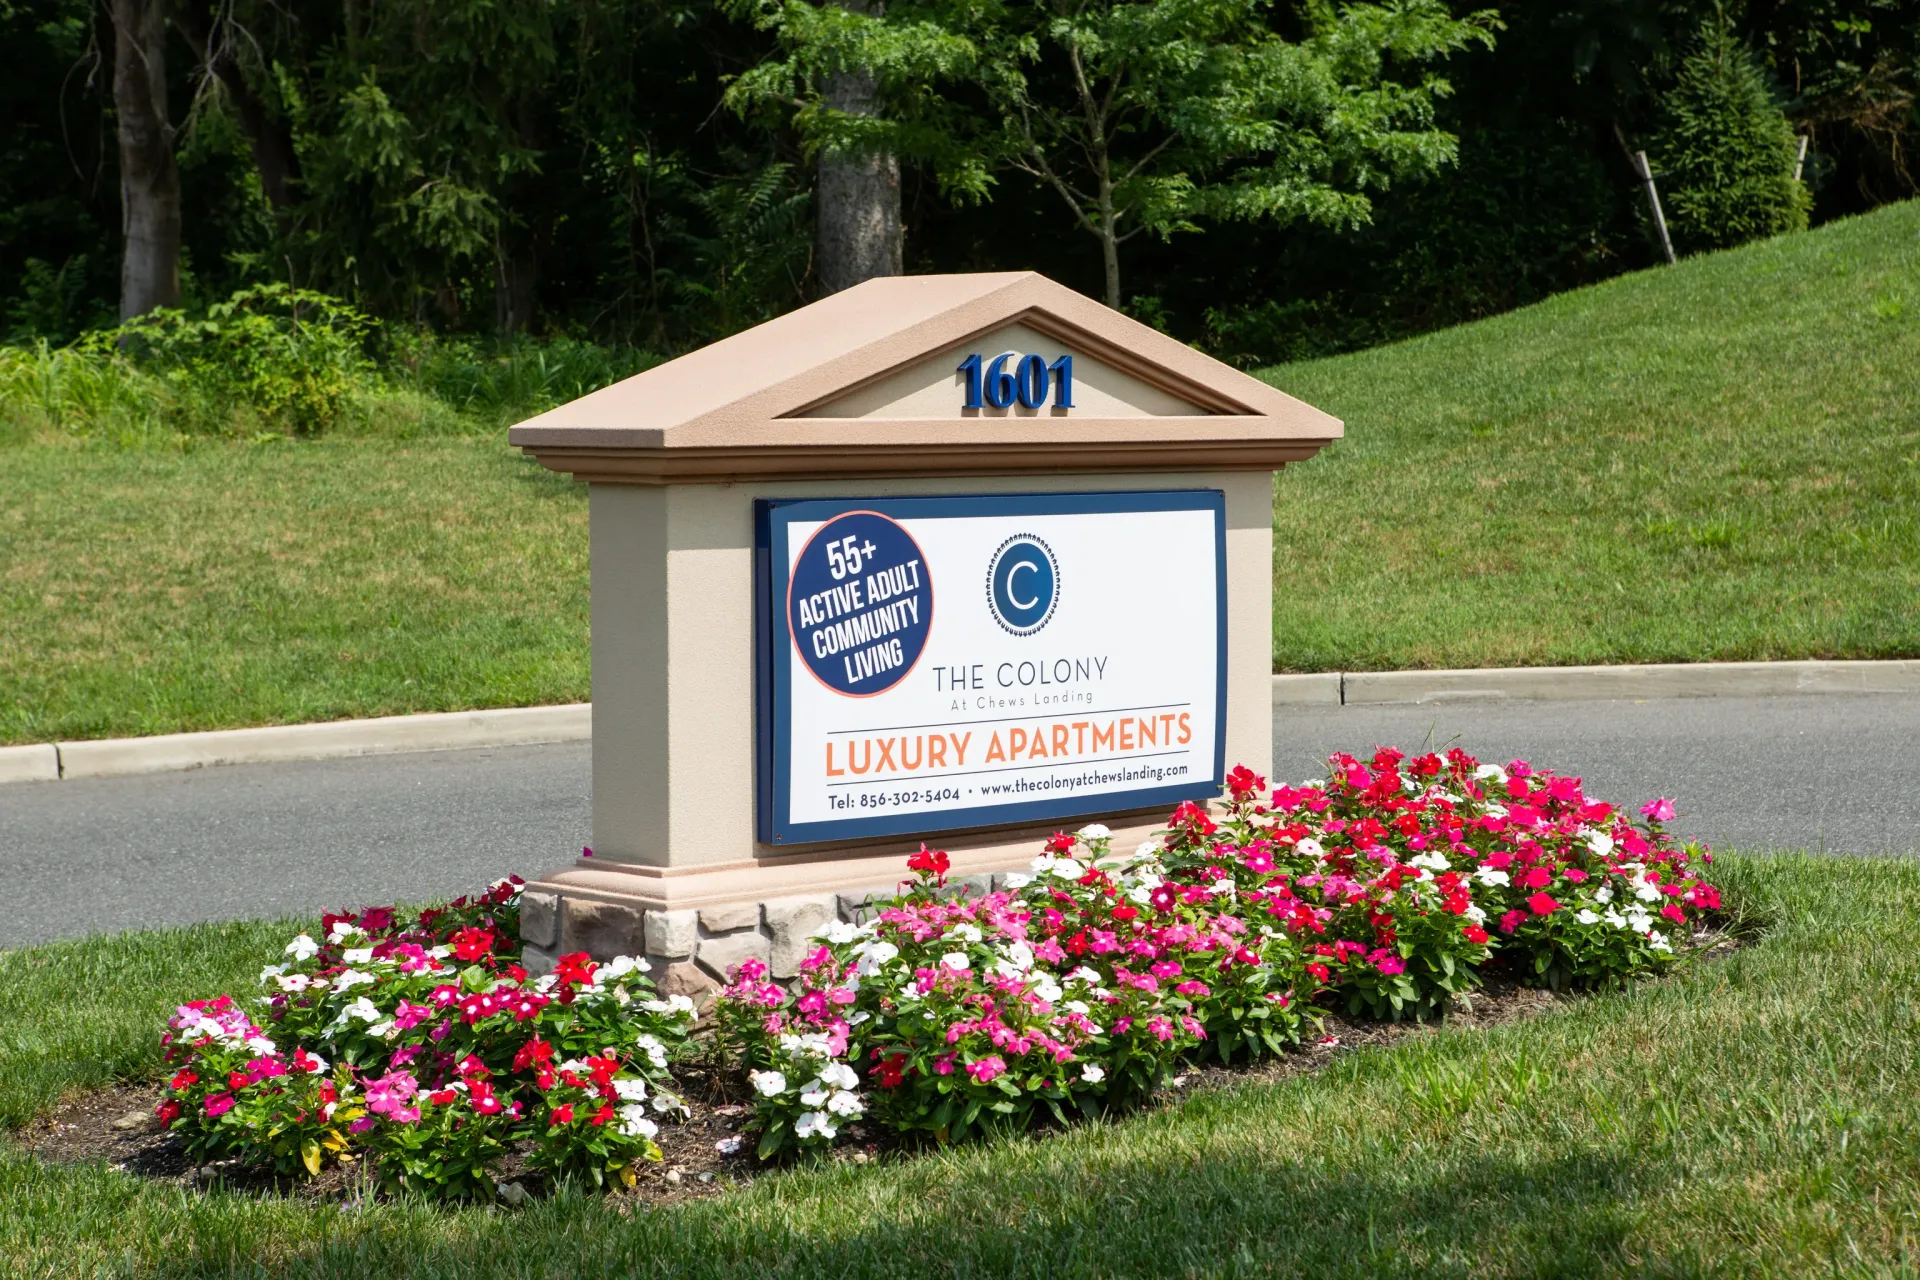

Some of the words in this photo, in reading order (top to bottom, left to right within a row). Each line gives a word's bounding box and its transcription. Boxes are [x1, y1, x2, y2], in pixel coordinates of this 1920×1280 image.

[957, 354, 1075, 408] 1601
[826, 535, 876, 580] 55+
[800, 580, 864, 628] ACTIVE
[866, 559, 920, 605] ADULT
[1007, 561, 1039, 610] C
[812, 595, 919, 659] COMMUNITY
[844, 638, 904, 684] LIVING
[932, 664, 984, 692] THE
[997, 656, 1108, 687] COLONY
[951, 699, 967, 711] At
[976, 694, 1025, 709] Chews
[1034, 690, 1093, 705] Landing
[826, 731, 972, 776] LUXURY
[985, 712, 1192, 763] APARTMENTS
[828, 795, 855, 810] Tel:
[860, 788, 960, 807] 856-302-5404
[981, 763, 1189, 797] www.thecolonyatchewslanding.com
